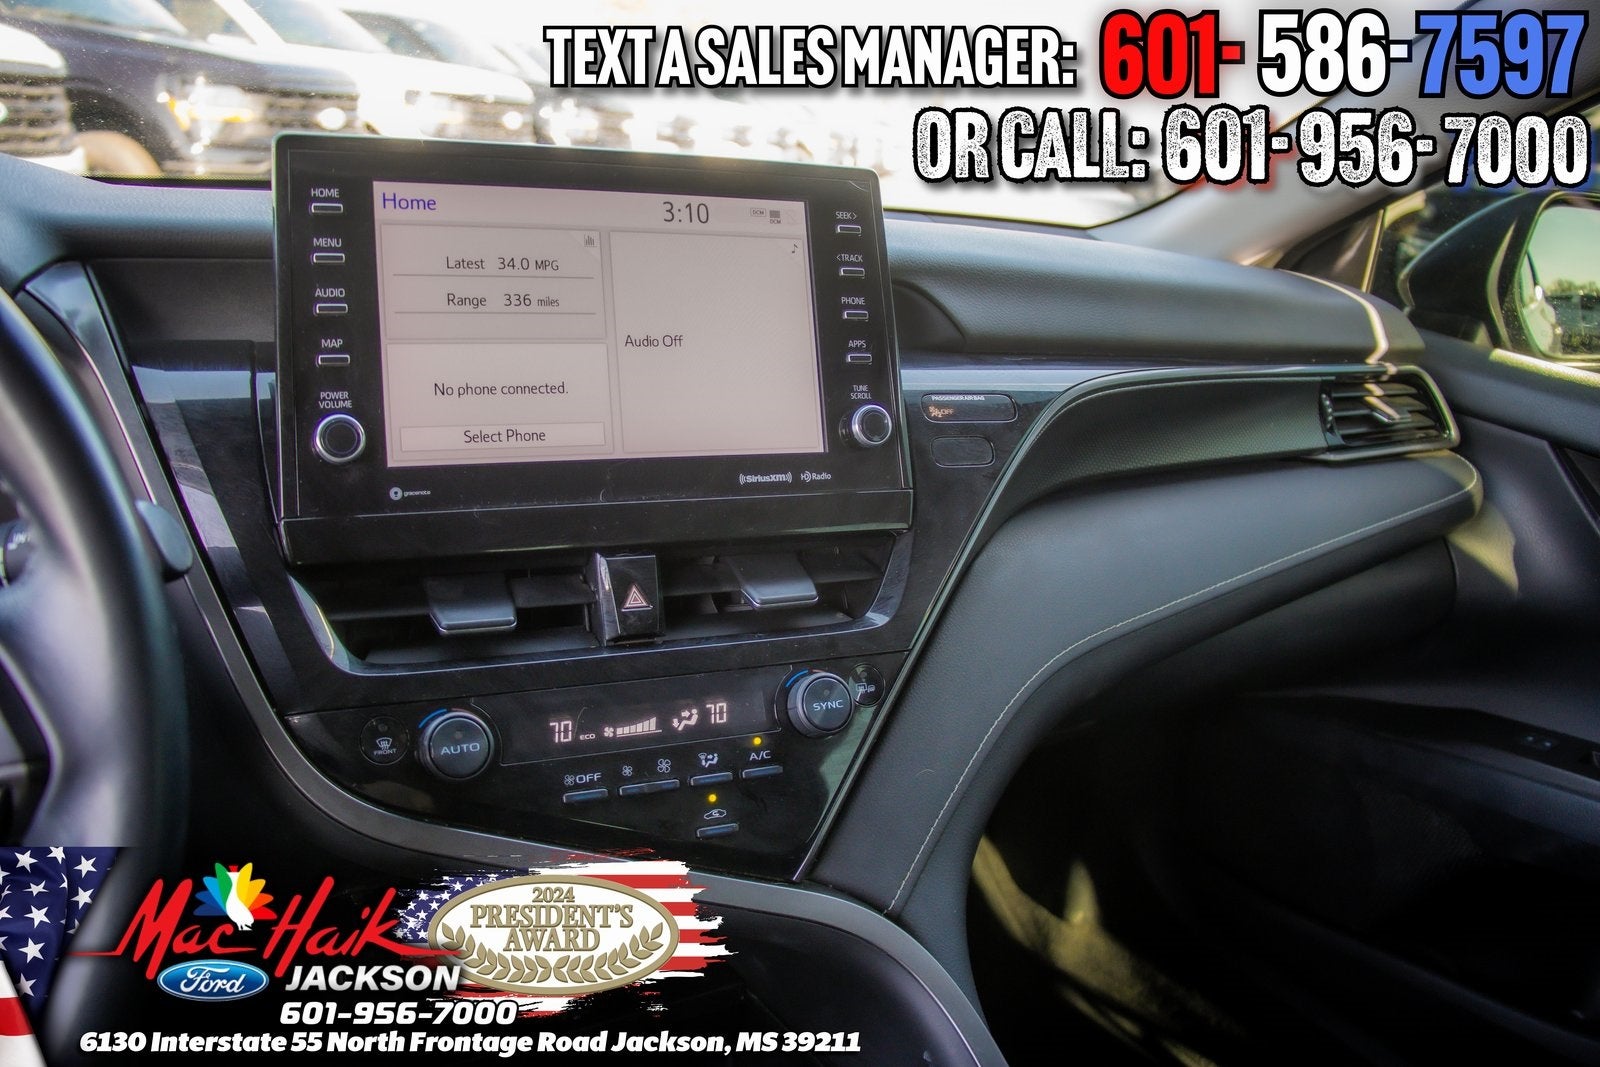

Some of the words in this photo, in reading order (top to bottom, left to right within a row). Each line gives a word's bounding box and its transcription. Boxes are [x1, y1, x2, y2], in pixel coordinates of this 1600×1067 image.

[310, 187, 340, 198] HOME
[382, 192, 437, 211] Home
[663, 201, 710, 224] 3:10
[313, 237, 342, 248] MENU
[446, 256, 486, 270] Latest
[497, 257, 530, 272] 34.0
[535, 260, 560, 272] MPG
[314, 287, 346, 298] AUDIO
[447, 293, 487, 308] Range
[503, 293, 532, 308] 336
[537, 295, 560, 308] miles
[841, 296, 866, 305] PHONE
[321, 338, 343, 349] MAP
[624, 334, 660, 348] Audio
[662, 334, 684, 348] Off
[848, 339, 867, 349] APPS
[433, 382, 454, 397] No
[457, 383, 498, 398] phone
[500, 381, 569, 396] connected.
[852, 384, 869, 392] TUNE
[320, 391, 350, 400] POWER
[850, 392, 872, 400] SCROLL
[318, 400, 353, 409] VOLUME
[463, 429, 503, 444] Select
[506, 429, 546, 443] Phone
[812, 472, 832, 481] Radio
[812, 699, 845, 711] SYNC
[706, 702, 727, 725] 70
[549, 720, 573, 744] 70
[579, 733, 596, 741] ECO
[440, 742, 481, 755] AUTO
[749, 750, 771, 761] A/C
[575, 772, 602, 784] OFF
